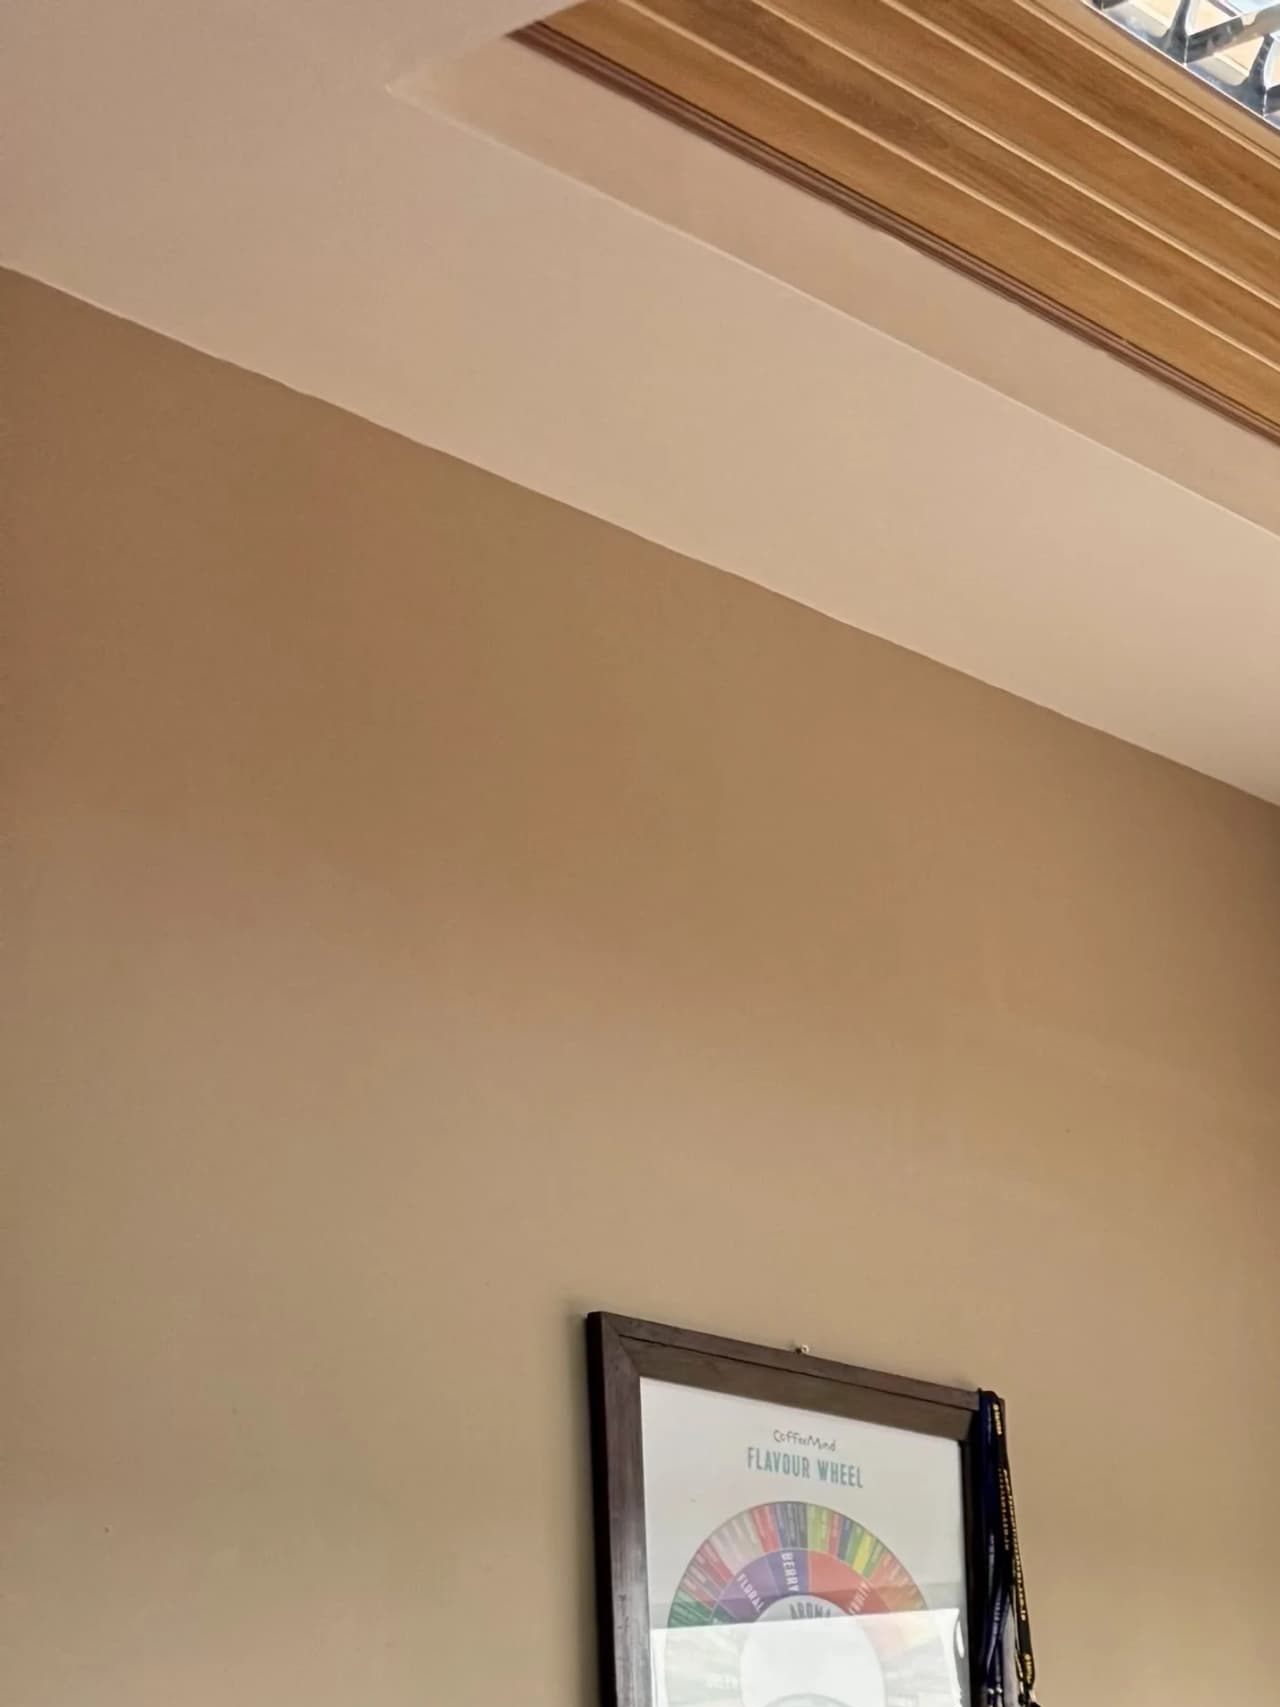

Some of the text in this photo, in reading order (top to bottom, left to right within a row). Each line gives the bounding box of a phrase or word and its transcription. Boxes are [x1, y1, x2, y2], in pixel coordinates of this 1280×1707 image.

[747, 1446, 864, 1489] FLAVOUR WHEEL
[737, 1572, 764, 1611] FLORAL
[781, 1553, 800, 1592] BERRY
